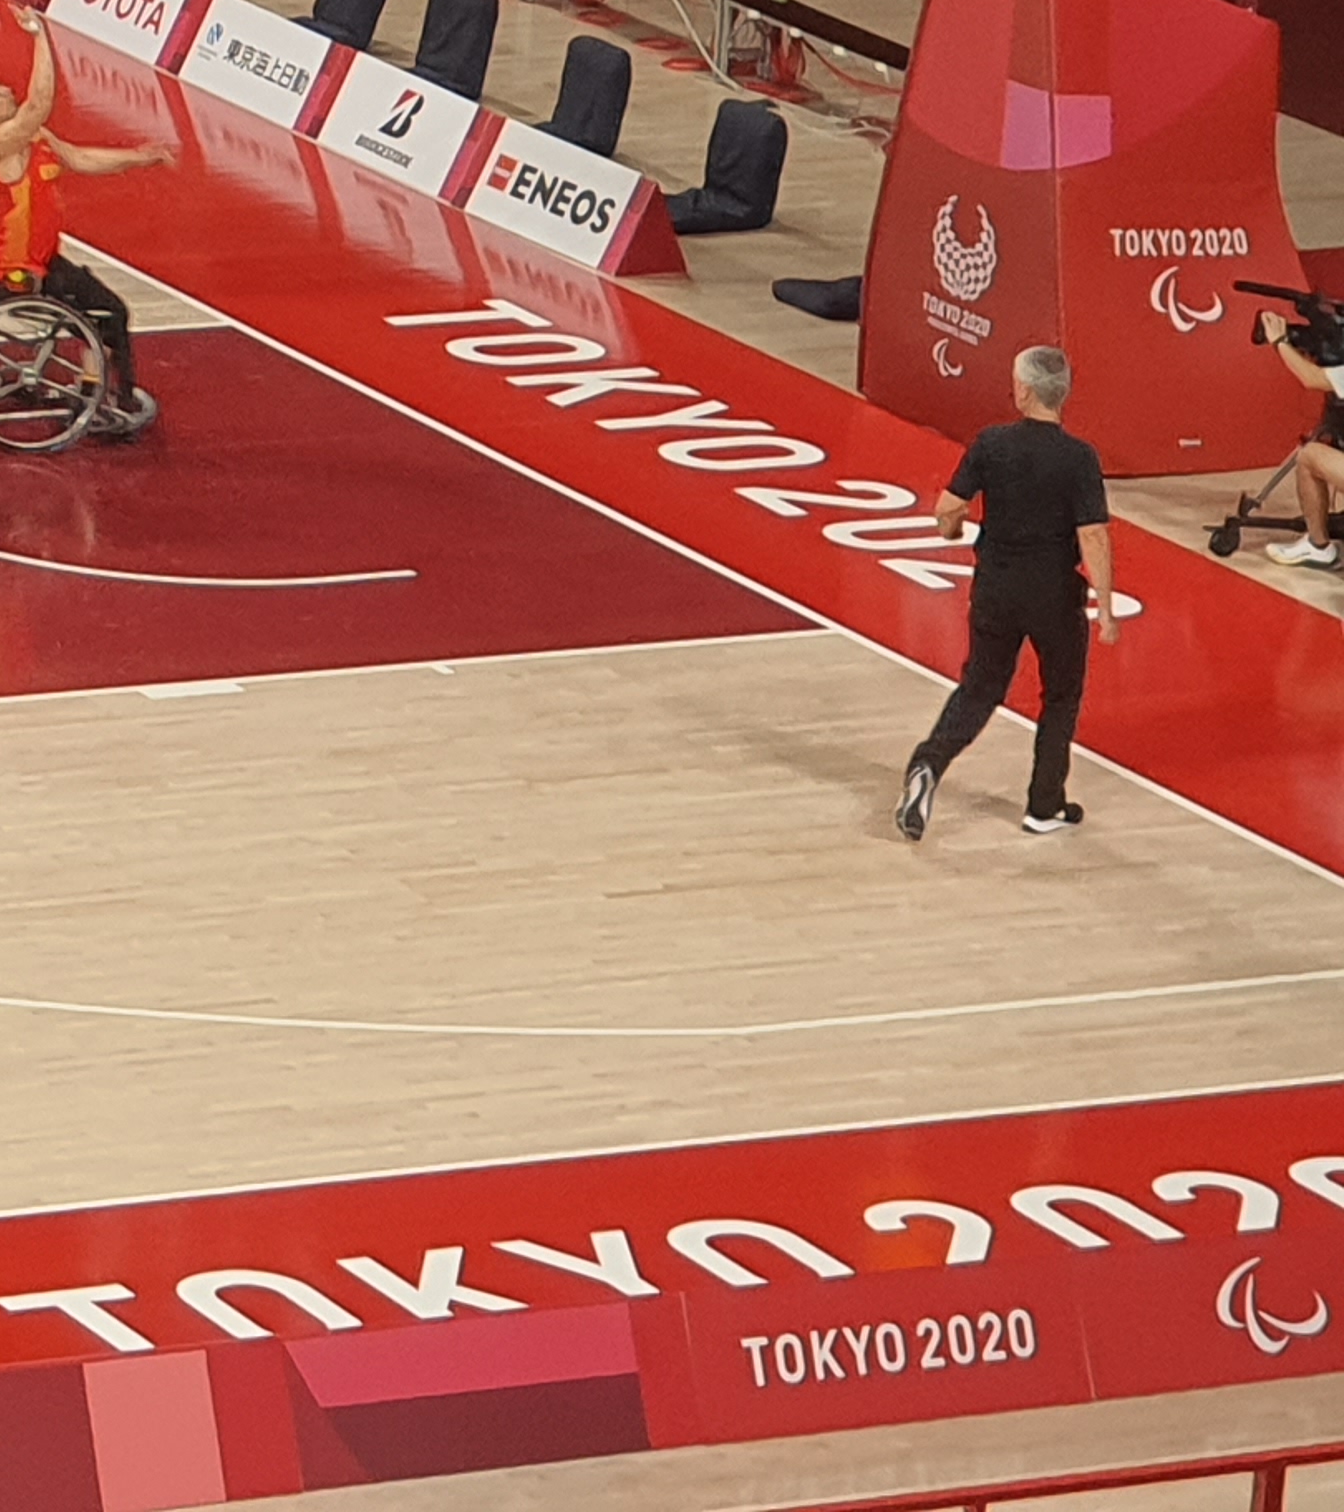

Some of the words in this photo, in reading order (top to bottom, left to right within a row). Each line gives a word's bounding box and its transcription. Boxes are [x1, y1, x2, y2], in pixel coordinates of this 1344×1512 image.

[509, 163, 616, 234] ENEOS
[1109, 228, 1187, 257] TOKYO
[1189, 226, 1249, 257] 2020
[384, 299, 826, 471] TOKYO
[740, 1322, 907, 1388] TOKYO
[915, 1308, 1036, 1370] 2020
